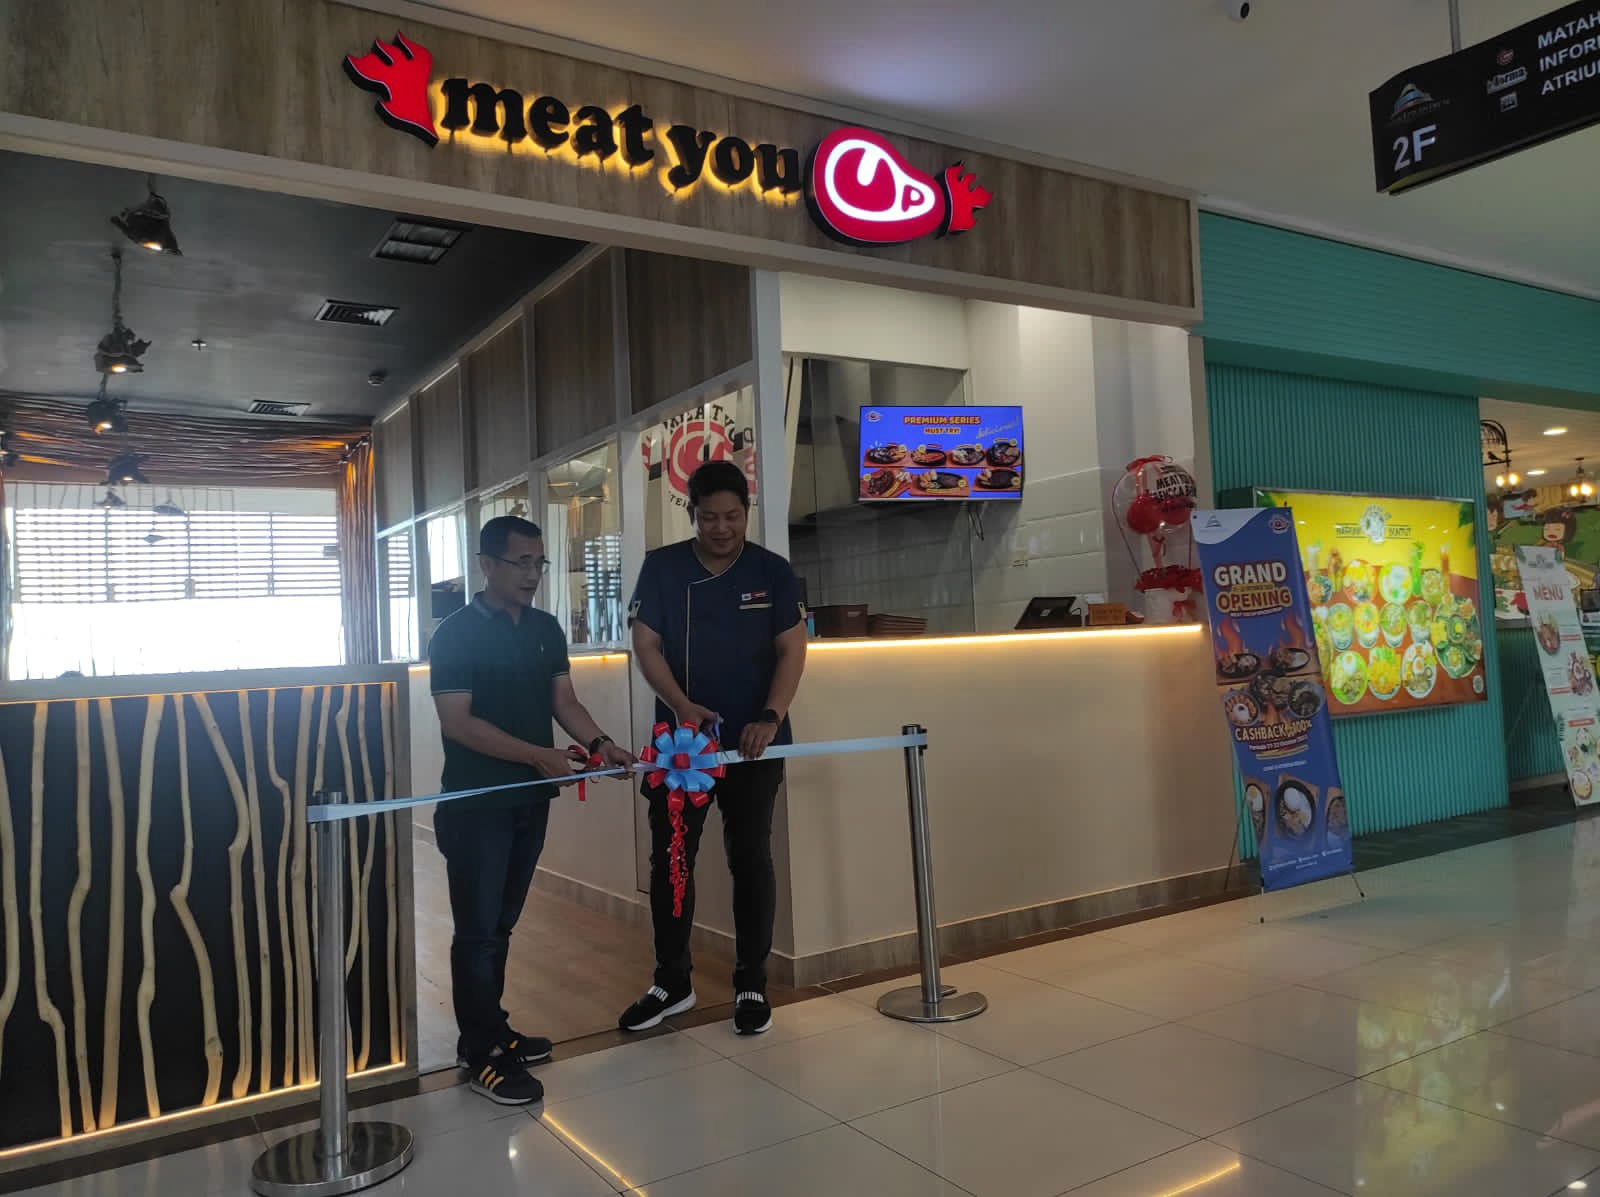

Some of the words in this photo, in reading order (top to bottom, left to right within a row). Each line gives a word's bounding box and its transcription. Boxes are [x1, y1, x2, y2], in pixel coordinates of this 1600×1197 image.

[440, 76, 654, 168] meat
[665, 124, 800, 192] you
[1392, 124, 1437, 172] 2F
[904, 416, 947, 425] PREMIUM
[949, 416, 981, 425] SERIES
[1214, 562, 1287, 586] GRAND
[1218, 589, 1291, 612] OPENING
[1532, 584, 1564, 601] MENU
[1235, 724, 1287, 741] CASHBACK
